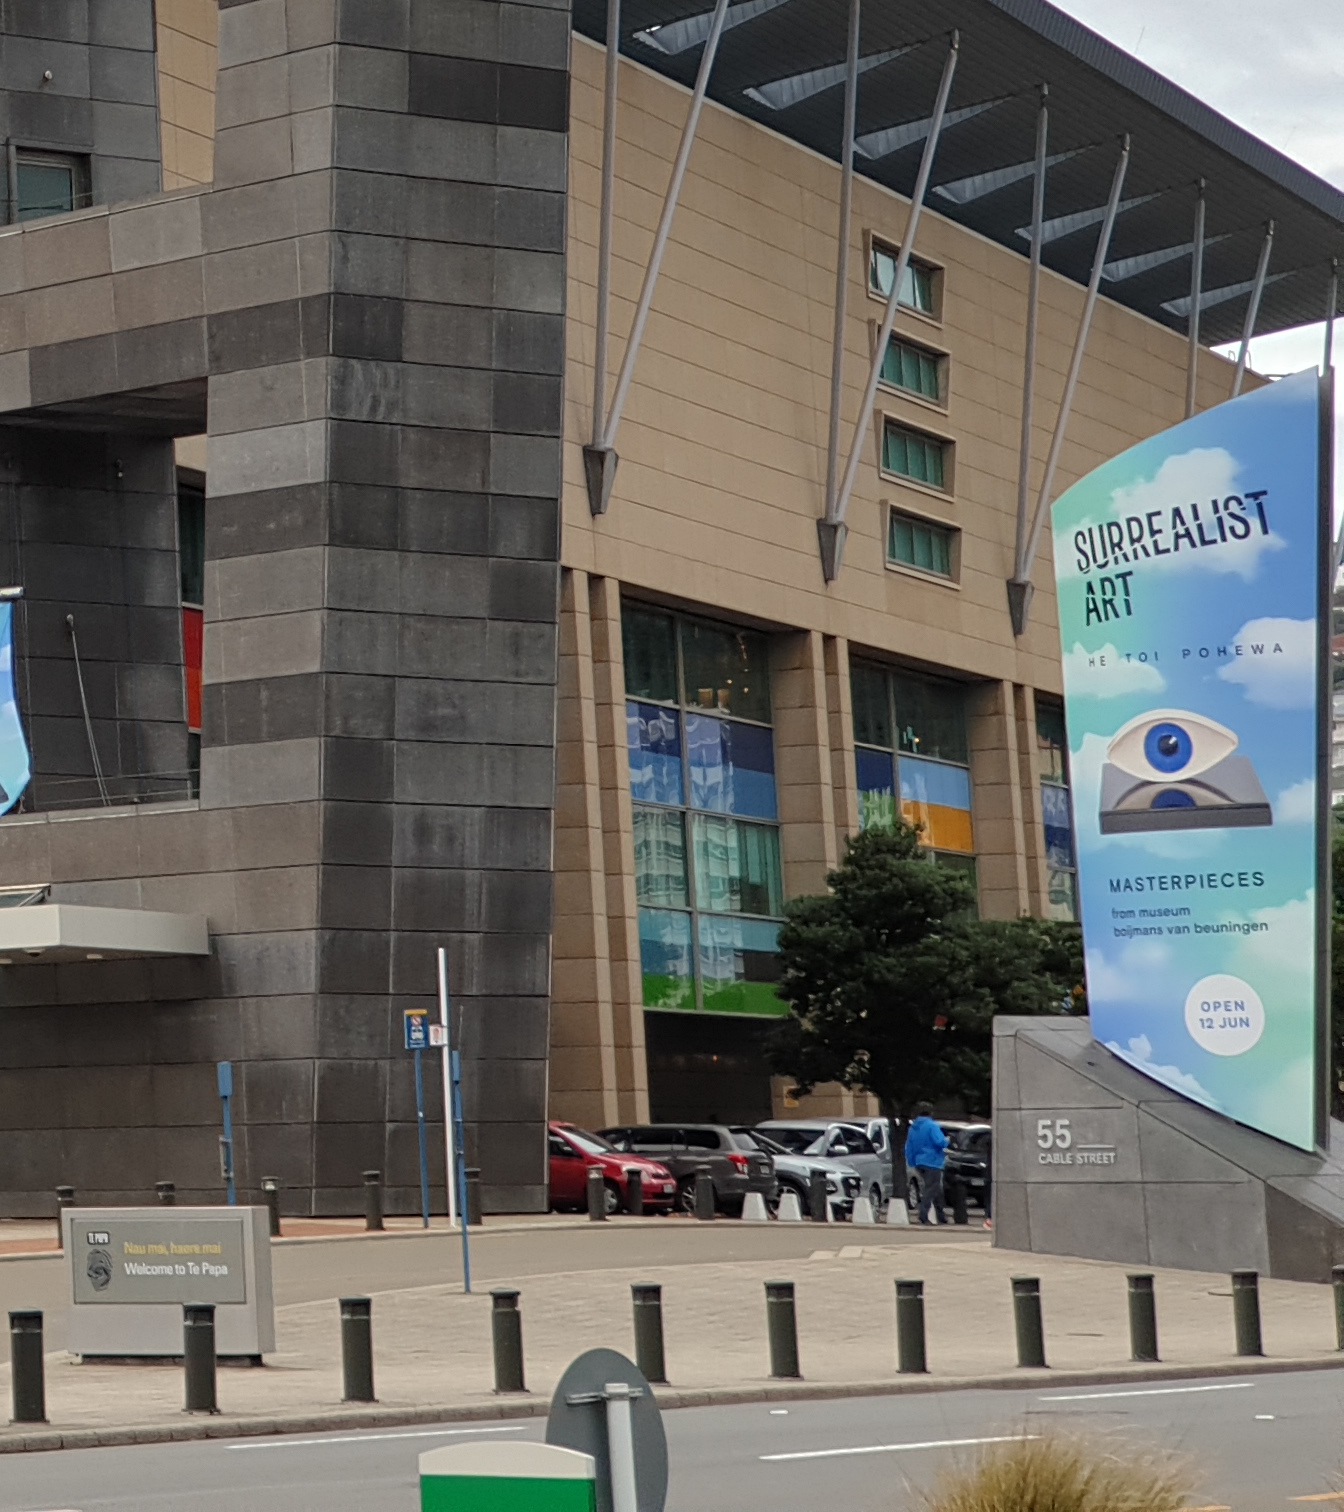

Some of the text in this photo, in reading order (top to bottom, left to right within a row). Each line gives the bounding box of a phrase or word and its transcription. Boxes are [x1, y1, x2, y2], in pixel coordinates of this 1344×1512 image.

[1073, 489, 1271, 575] SURREALIST
[1085, 571, 1134, 626] ART
[1088, 643, 1284, 668] HE TOI POHEWA
[1109, 871, 1265, 893] MASTERPIECES
[1111, 906, 1191, 919] from museum
[1113, 921, 1269, 939] boijmans van beuningen
[1201, 1000, 1245, 1013] OPEN
[1199, 1017, 1250, 1029] 12 JUN
[1037, 1119, 1072, 1149] 55
[1038, 1152, 1116, 1165] CABLE STREET
[124, 1262, 228, 1277] Welcome to Te Papa
